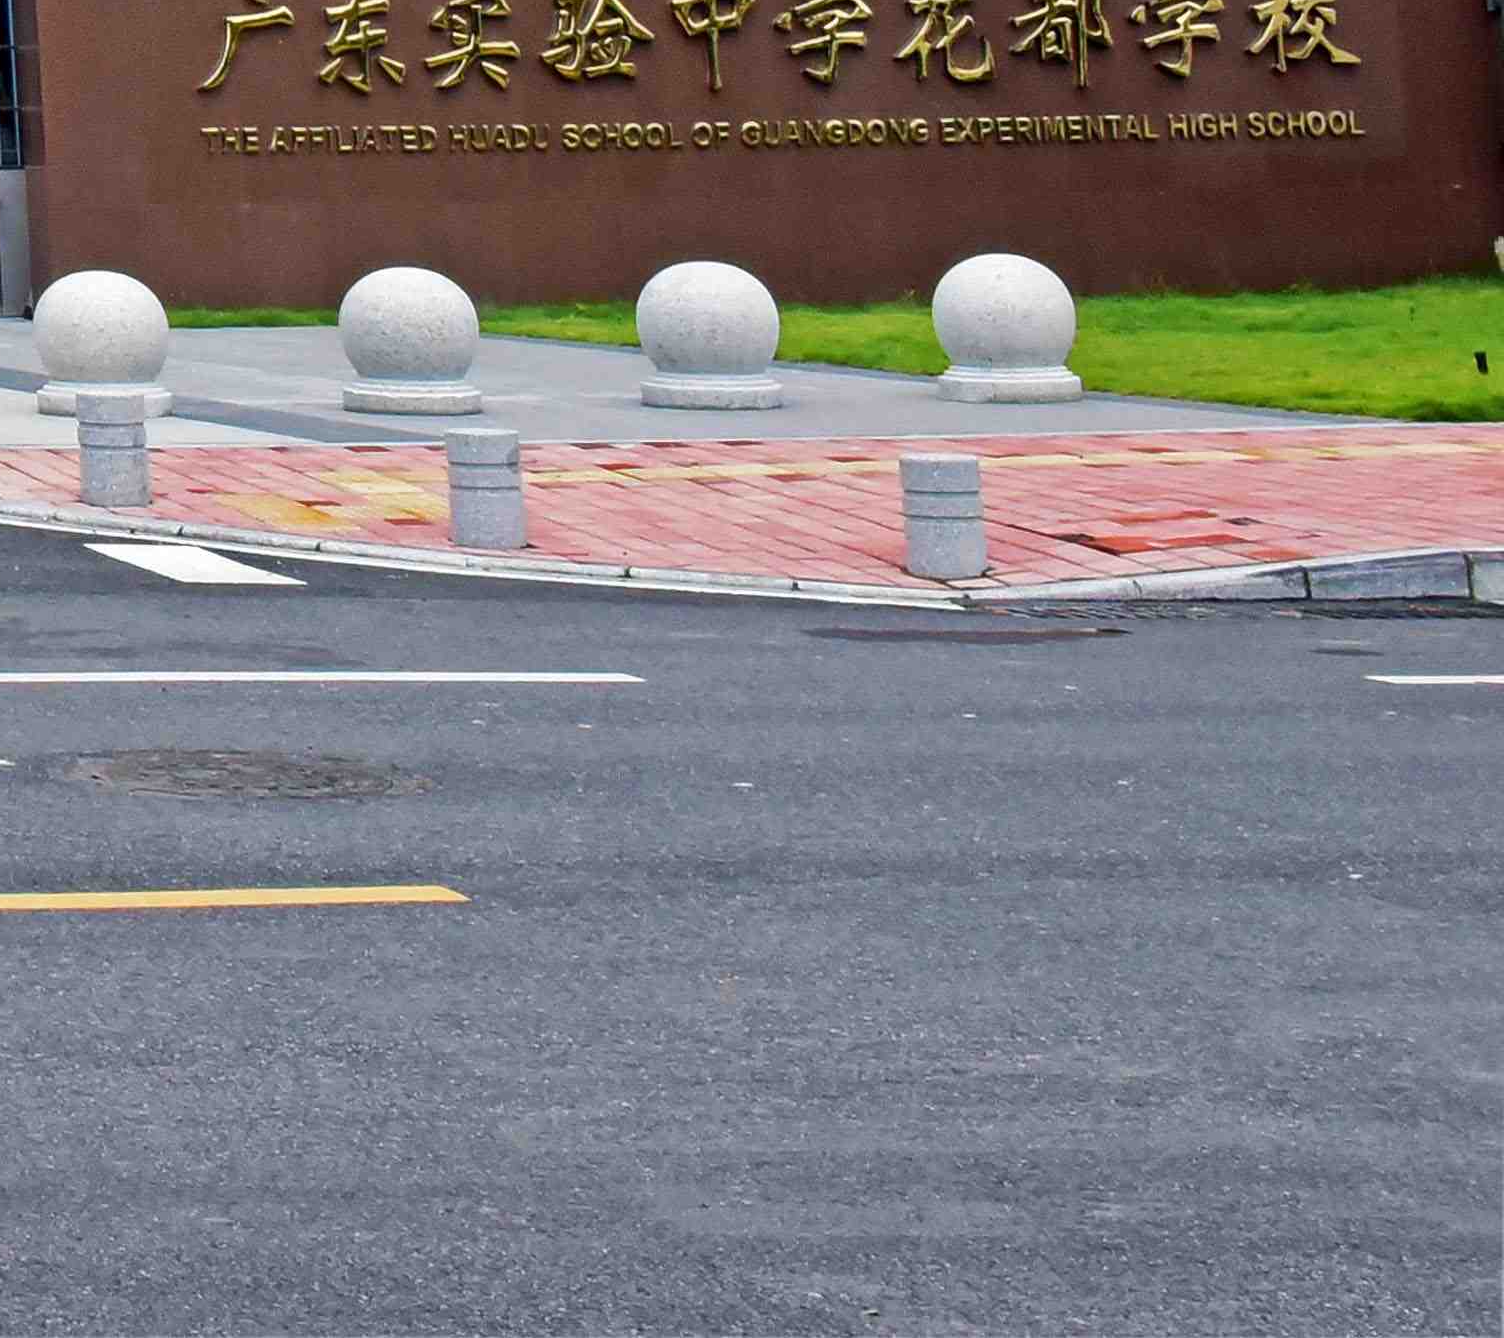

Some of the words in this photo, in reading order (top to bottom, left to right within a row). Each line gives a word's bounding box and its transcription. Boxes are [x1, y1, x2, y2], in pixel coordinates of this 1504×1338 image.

[201, 125, 259, 155] THE
[270, 124, 437, 154] AFFILIATED
[447, 123, 550, 152] HUADU
[562, 121, 683, 150] SCHOOL
[692, 120, 729, 147] OF
[740, 117, 930, 146] GUANGDONG
[940, 113, 1159, 143] EXPERIMENTAL
[1169, 111, 1239, 139] HIGH
[1246, 109, 1365, 137] SCHOOL
